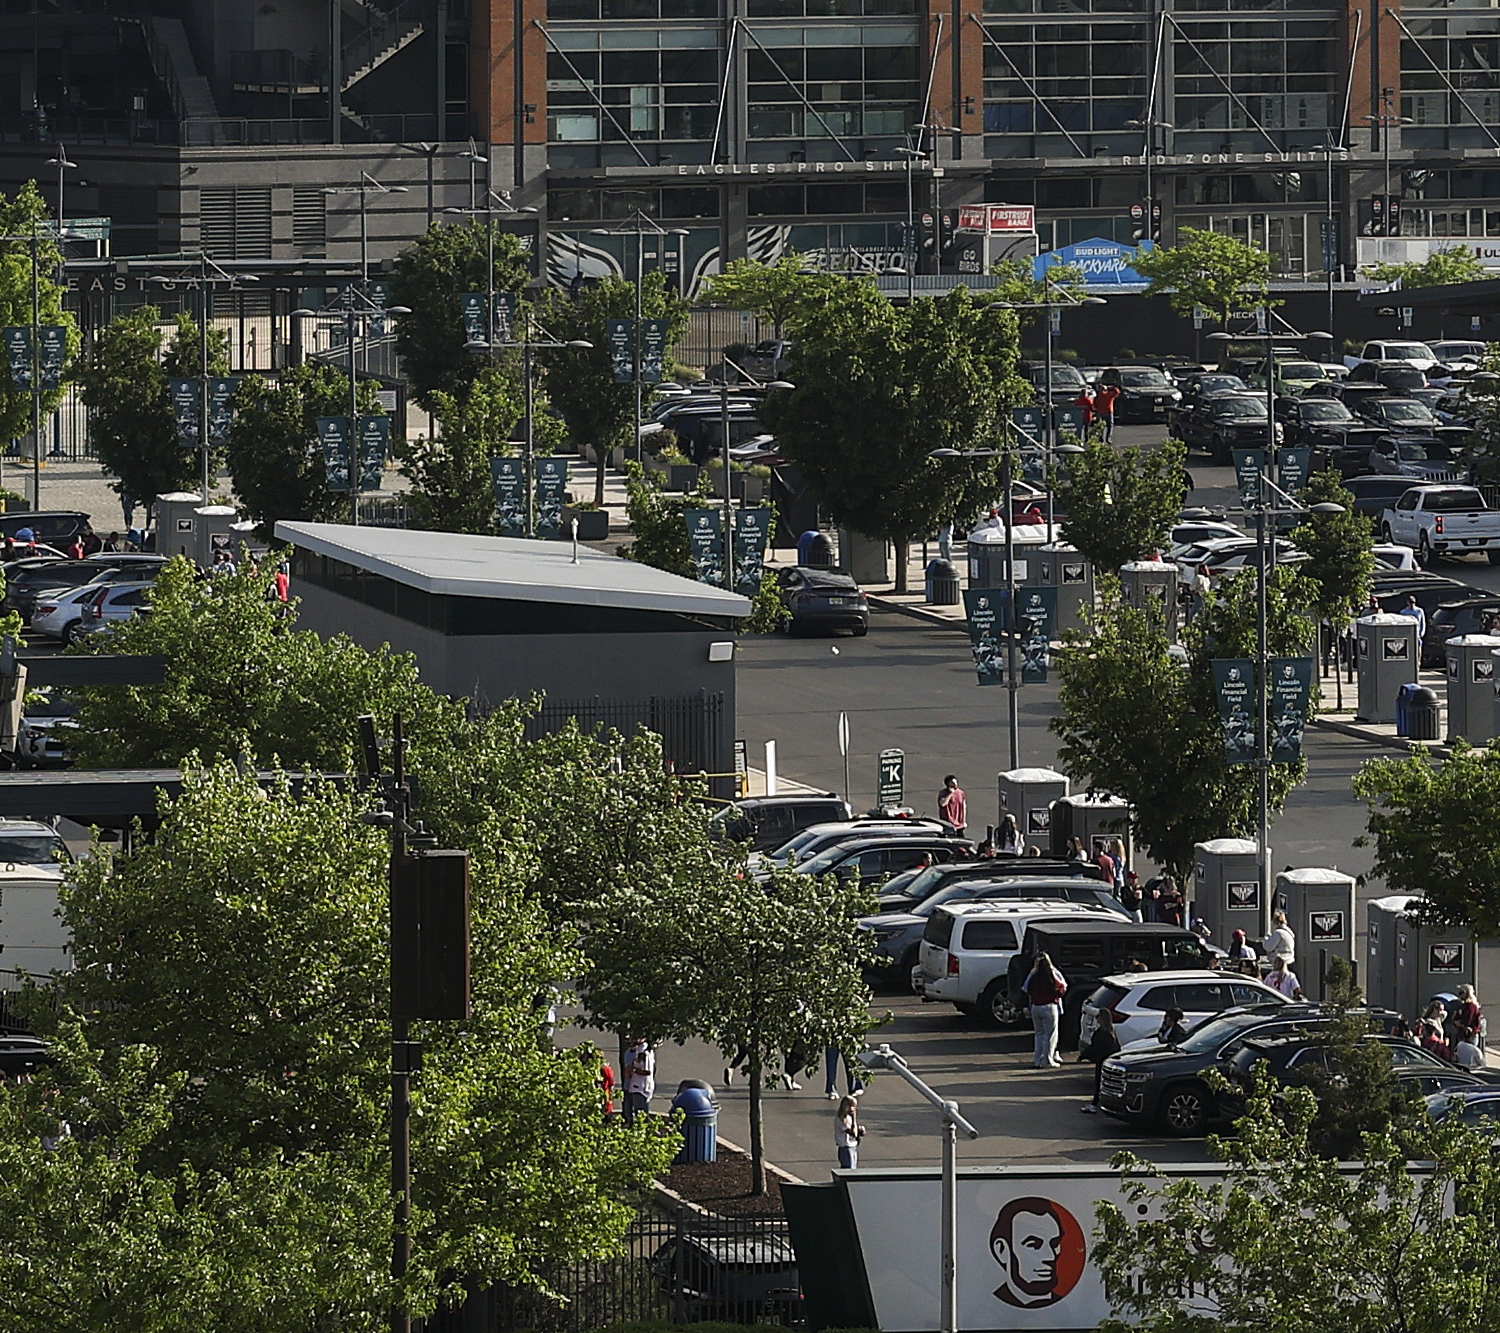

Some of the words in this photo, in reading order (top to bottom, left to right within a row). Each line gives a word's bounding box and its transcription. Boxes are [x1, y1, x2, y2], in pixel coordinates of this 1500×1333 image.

[1123, 155, 1165, 166] RED
[1186, 153, 1244, 165] ZONE
[679, 163, 775, 176] EAGLES
[797, 161, 844, 174] PRO
[963, 250, 976, 261] GO
[1075, 247, 1093, 256] BUD
[1094, 247, 1119, 256] LIGHT
[959, 261, 981, 273] BIRDS
[67, 277, 147, 292] EAST
[1221, 687, 1248, 695] Financial
[1227, 694, 1243, 702] Field
[1281, 693, 1297, 701] Field
[889, 764, 900, 782] K
